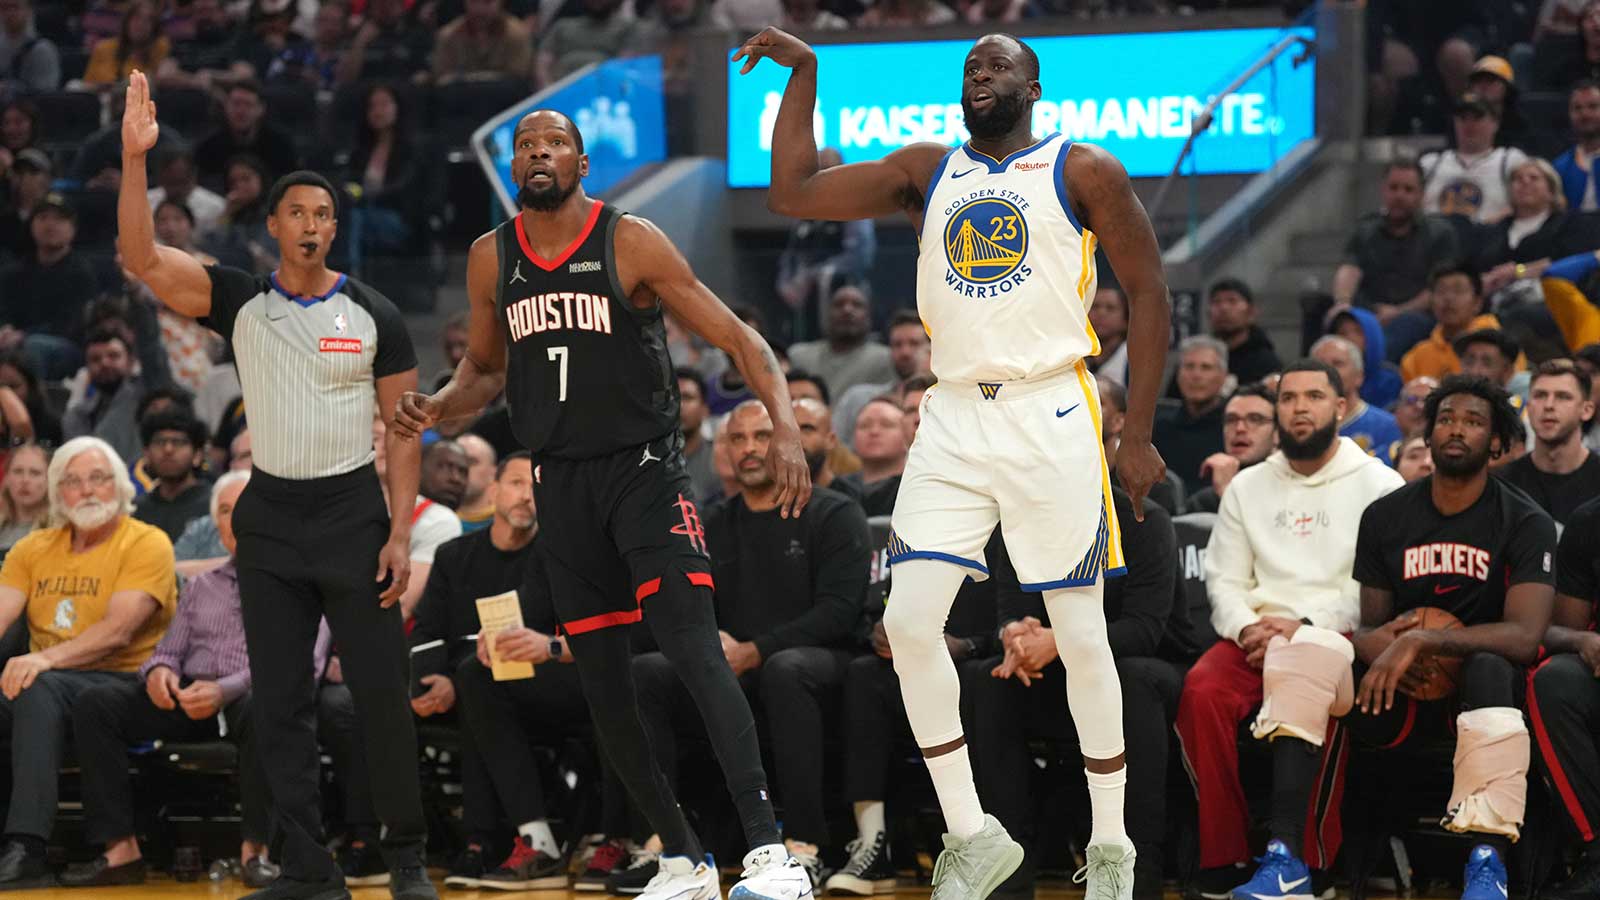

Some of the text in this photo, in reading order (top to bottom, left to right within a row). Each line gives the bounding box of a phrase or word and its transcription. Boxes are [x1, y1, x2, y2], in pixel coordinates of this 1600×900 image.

[839, 93, 1265, 147] KAISER RMANENTE
[1014, 162, 1050, 171] Rakuten
[944, 188, 1031, 217] GOLDEN STATE
[989, 216, 1018, 241] 23
[945, 264, 1033, 299] WARRIORS
[506, 292, 613, 342] HOUSTON
[320, 340, 362, 351] Emirates
[547, 346, 569, 402] 7
[1403, 543, 1491, 582] ROCKETS
